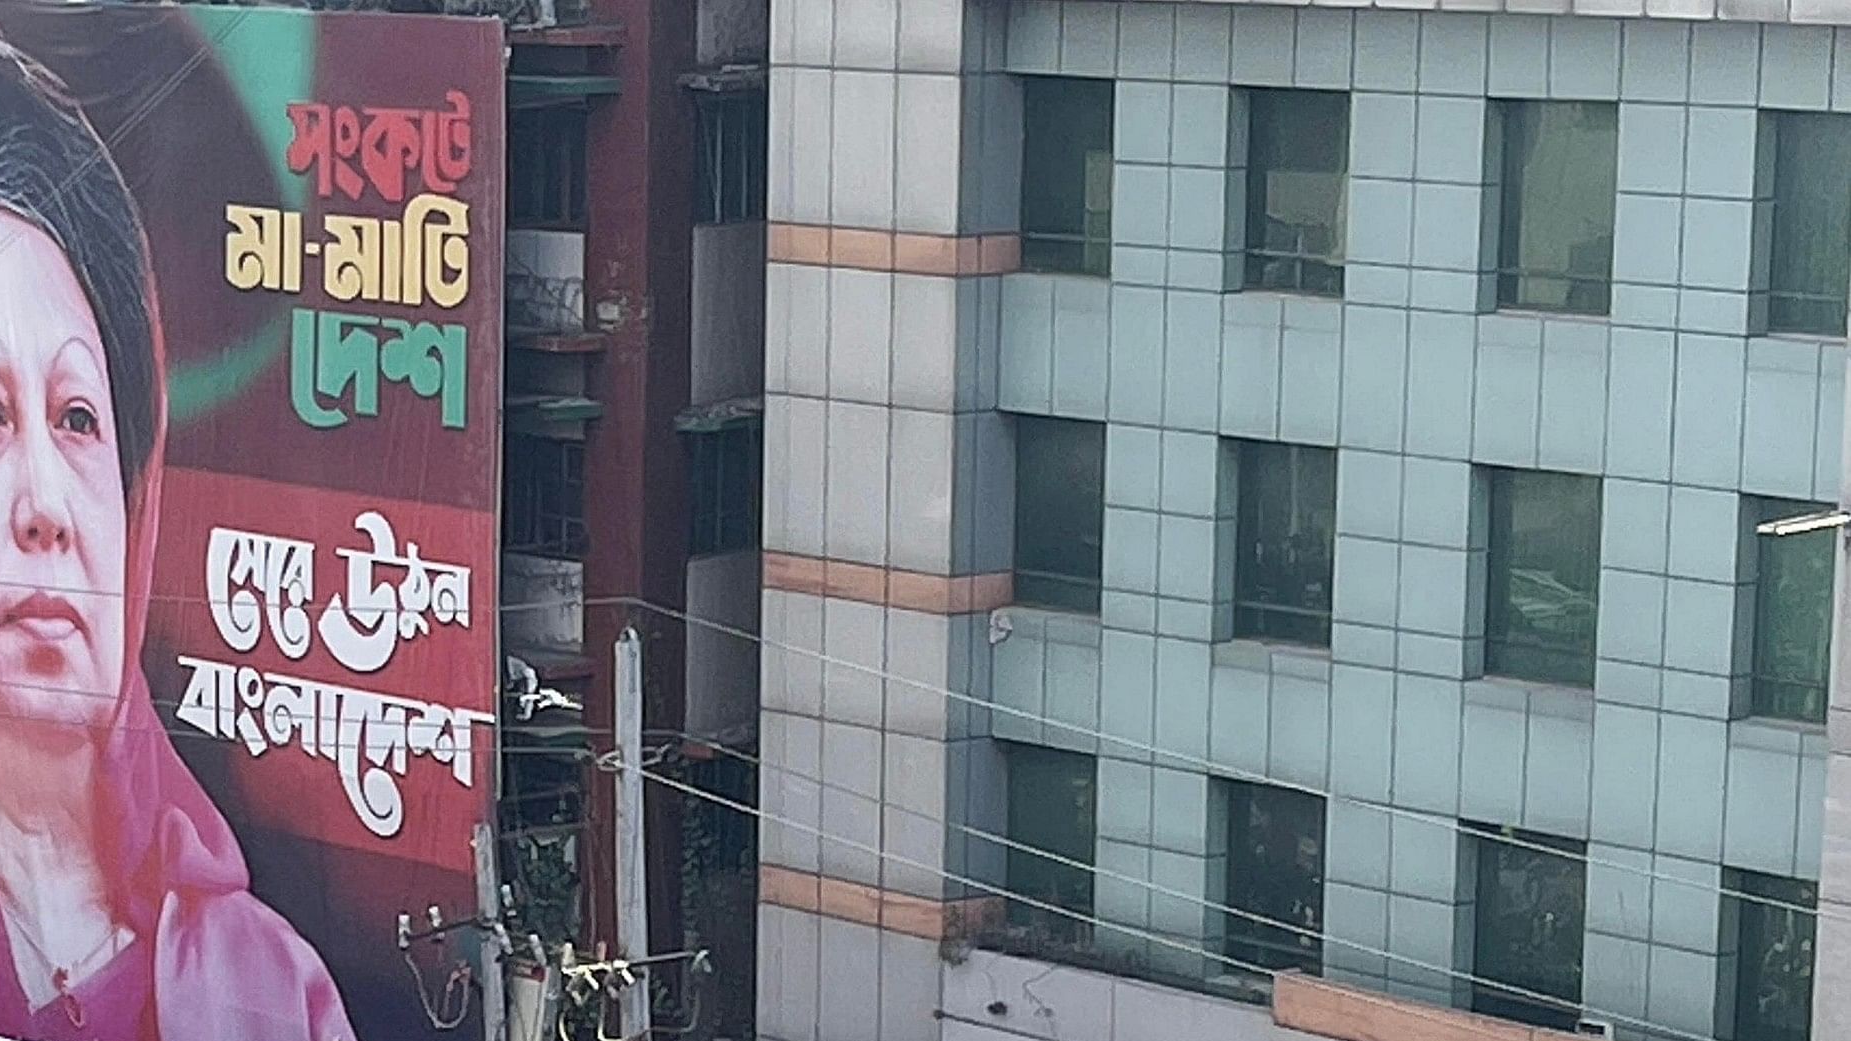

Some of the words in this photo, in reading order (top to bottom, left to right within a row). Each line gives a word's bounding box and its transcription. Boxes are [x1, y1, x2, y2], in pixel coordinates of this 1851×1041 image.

[286, 91, 473, 201] সংকটে
[225, 193, 470, 309] মা-মাটি
[289, 308, 469, 430] দেশ
[207, 526, 315, 662] সেরে
[319, 512, 472, 672] উঠুন
[177, 656, 495, 838] বাংলাদেশ
